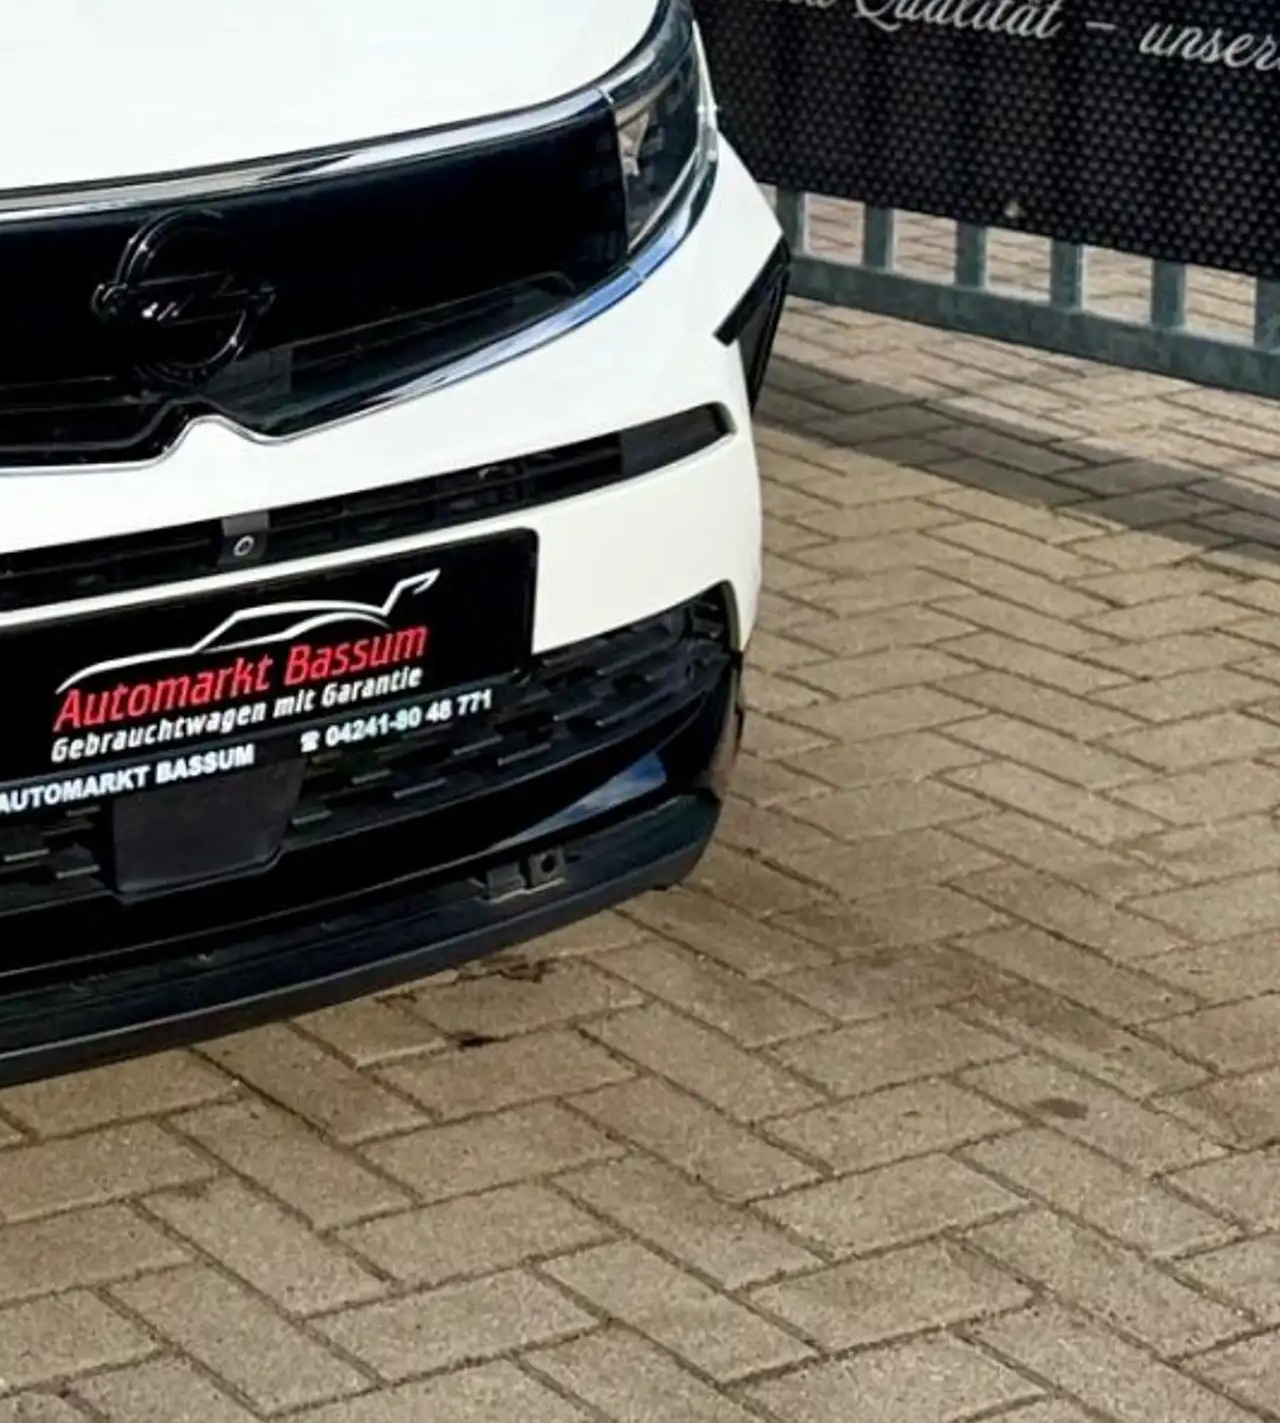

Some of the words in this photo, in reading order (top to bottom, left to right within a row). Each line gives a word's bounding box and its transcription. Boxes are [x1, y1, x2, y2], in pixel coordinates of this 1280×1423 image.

[1139, 22, 1280, 71] unser
[51, 701, 266, 763] Gebrauchtwagen
[273, 689, 316, 719] mit
[321, 666, 423, 707] Garantie
[52, 655, 274, 732] Automarkt
[283, 626, 428, 686] Bassum
[155, 743, 255, 783] BASSUM
[425, 698, 453, 723] 48
[457, 688, 493, 716] 771
